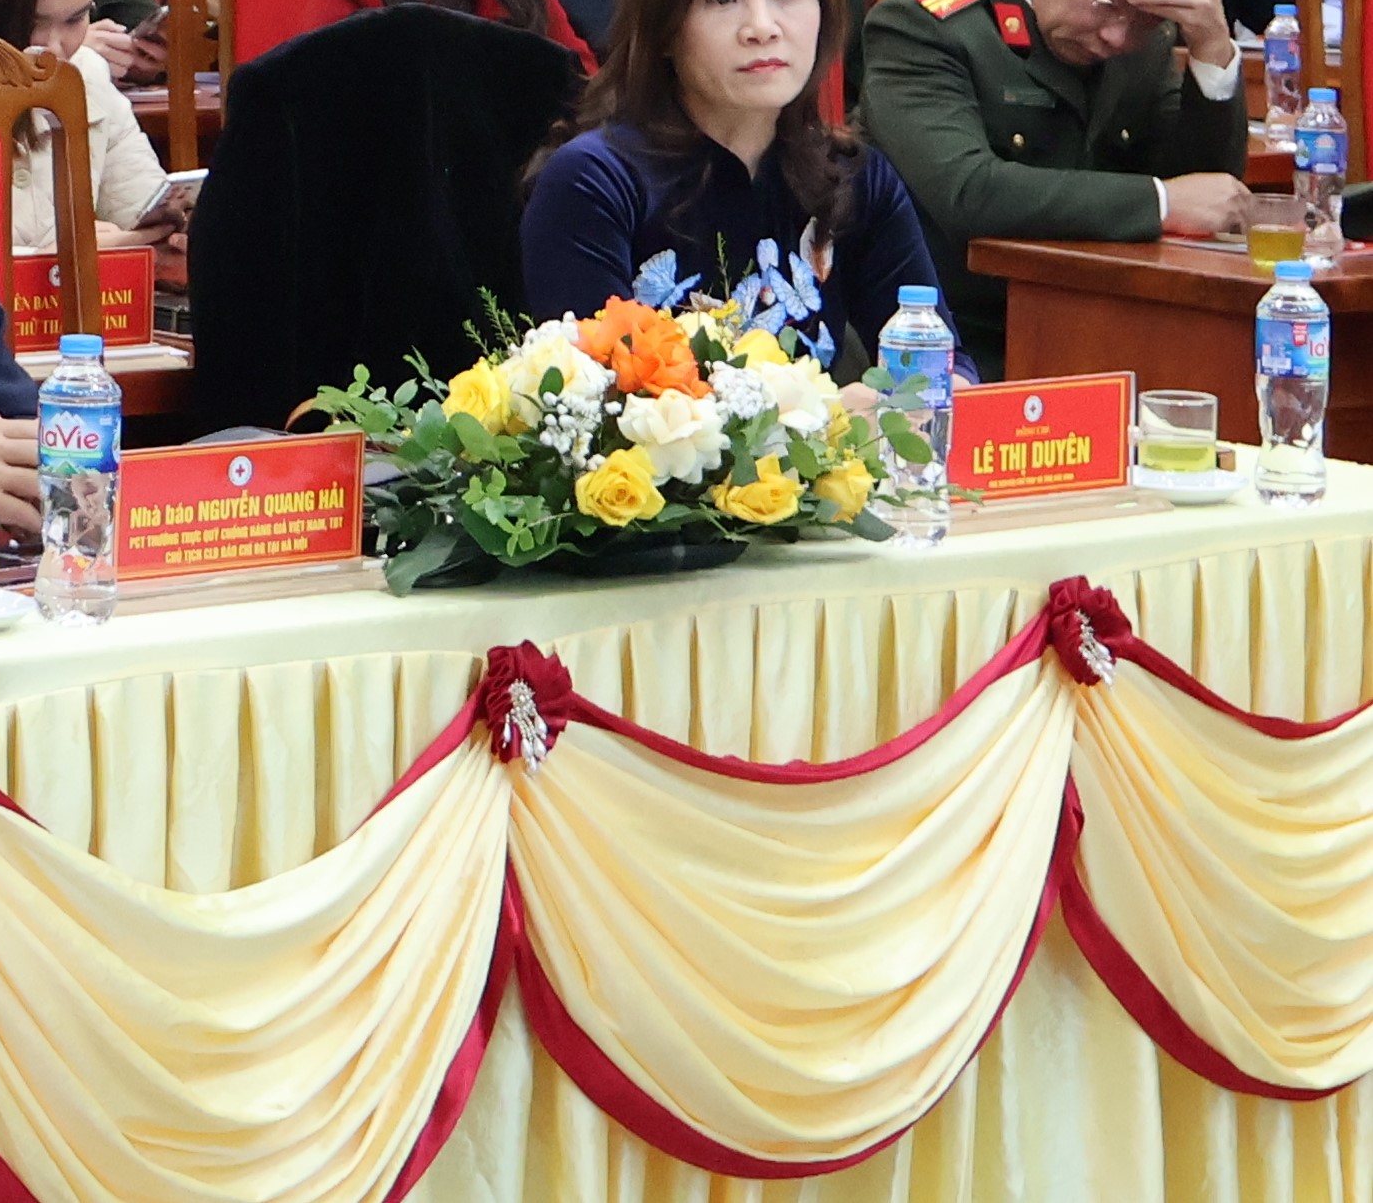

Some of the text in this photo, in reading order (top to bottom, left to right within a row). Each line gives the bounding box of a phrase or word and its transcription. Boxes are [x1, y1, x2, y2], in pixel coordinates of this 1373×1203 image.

[973, 432, 1091, 476] LÊ THỊ DUYÊN
[130, 481, 345, 529] Nhà báo NGUYỄN QUANG HẢI
